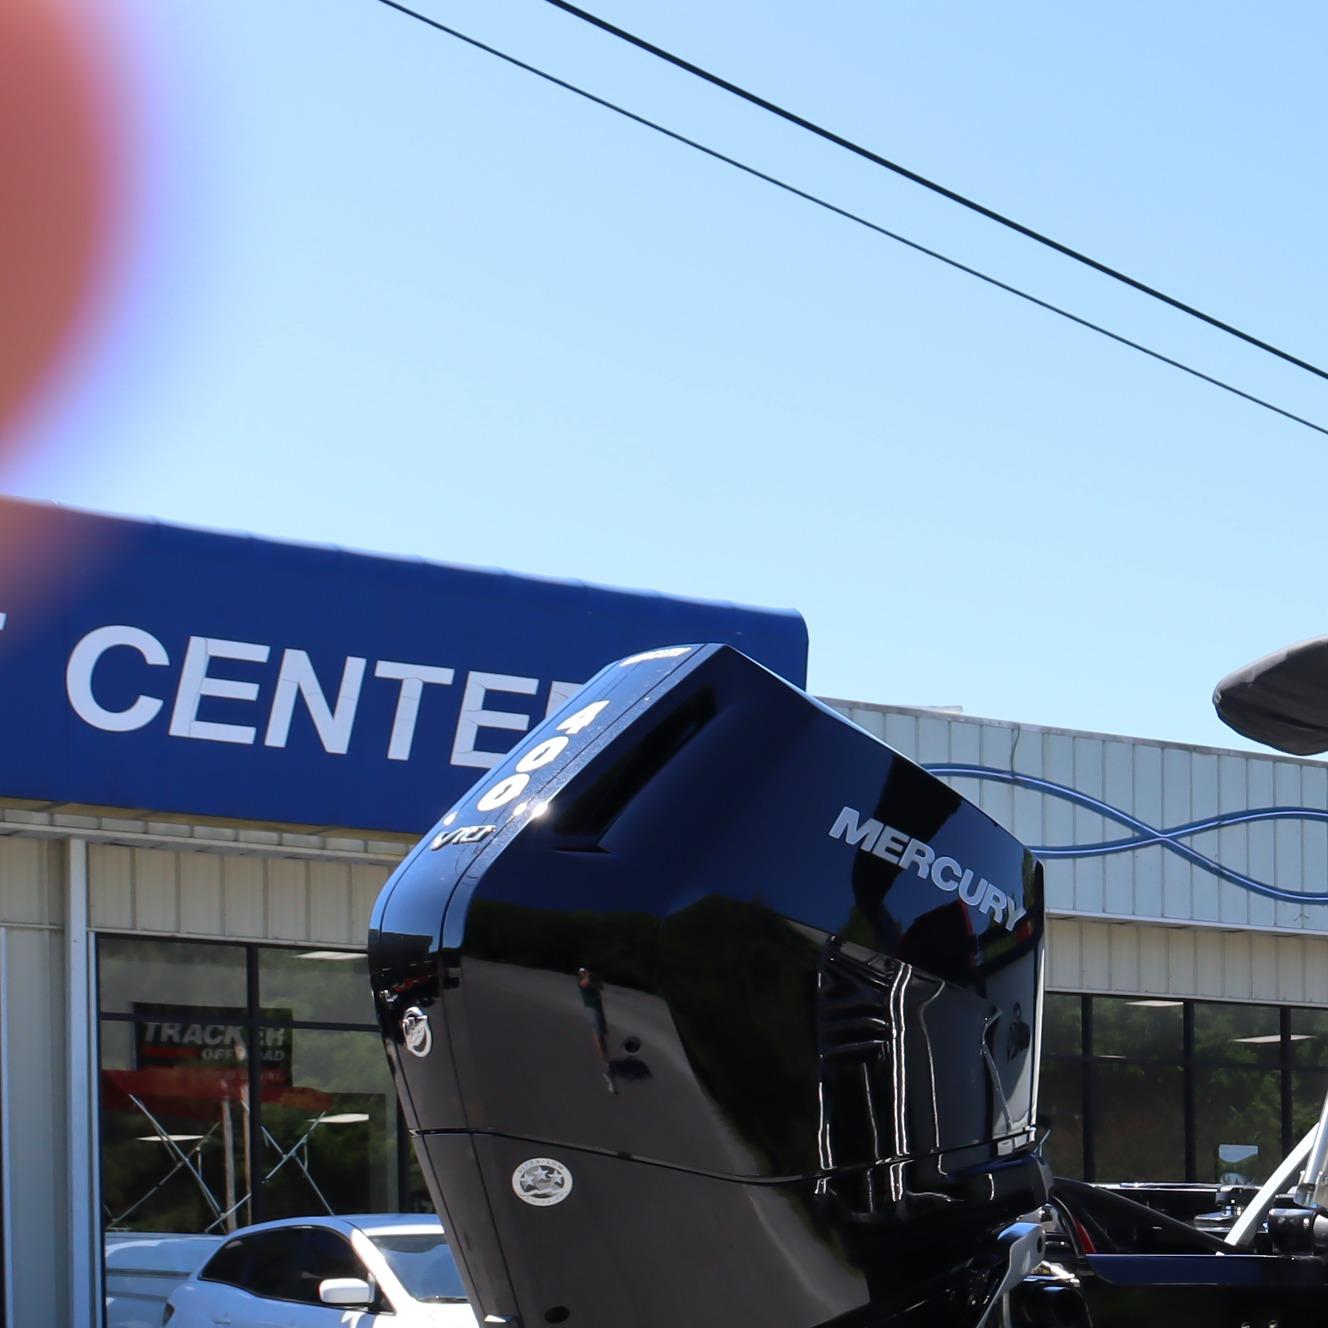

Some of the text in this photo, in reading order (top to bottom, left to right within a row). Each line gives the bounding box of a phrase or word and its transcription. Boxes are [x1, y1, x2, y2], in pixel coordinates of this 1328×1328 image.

[66, 624, 586, 769] CENTE
[477, 700, 610, 812] 400
[828, 805, 1038, 932] MERCURY
